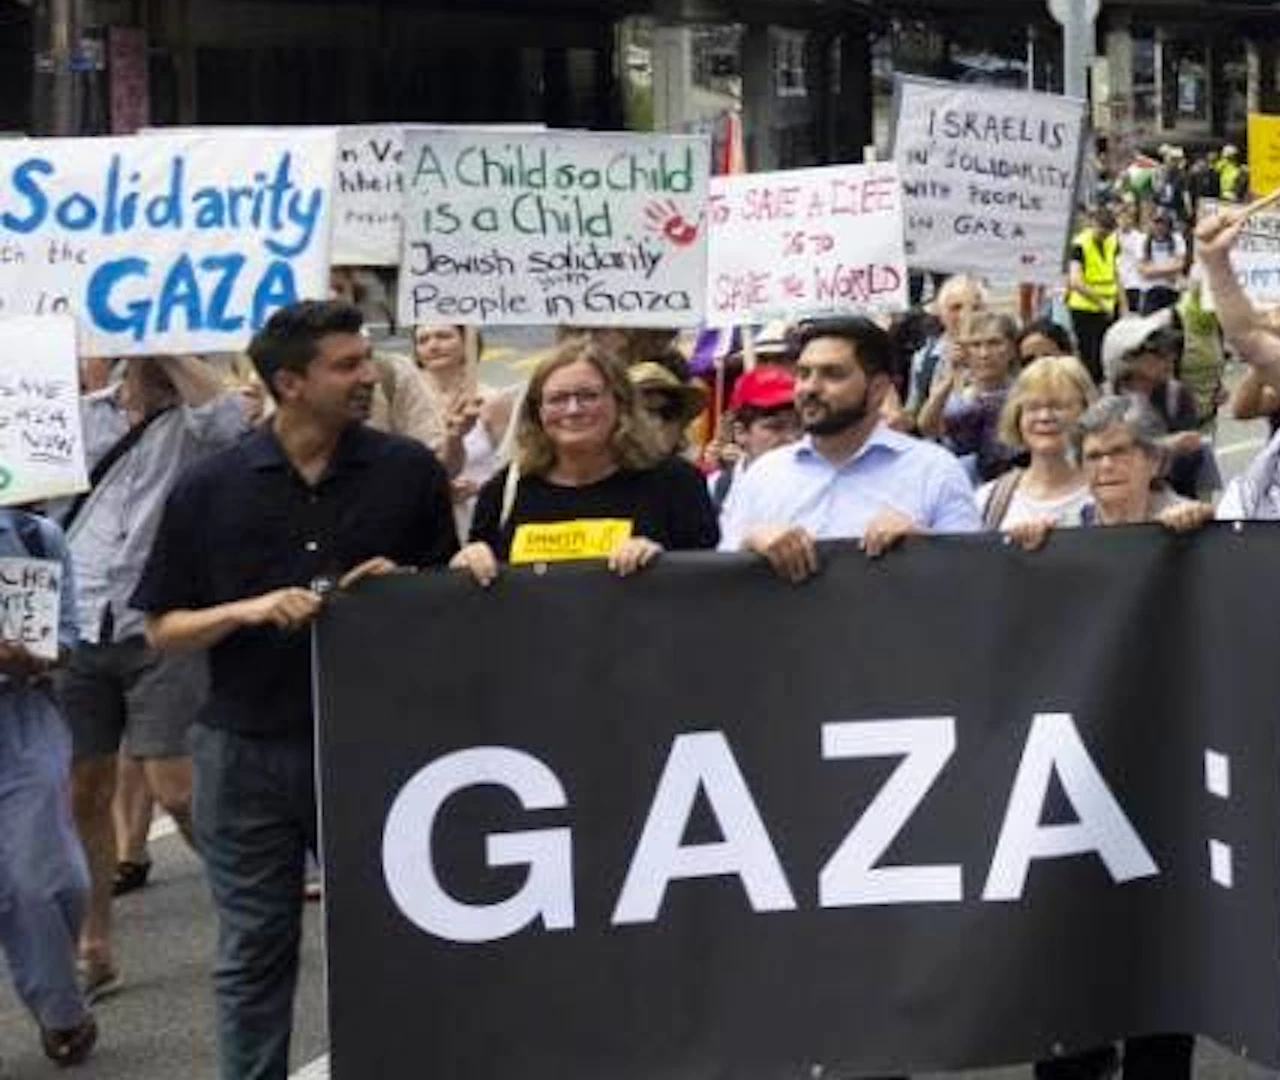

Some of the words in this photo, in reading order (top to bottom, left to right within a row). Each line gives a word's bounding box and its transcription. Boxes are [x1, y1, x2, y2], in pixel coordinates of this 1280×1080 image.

[928, 108, 1067, 151] ISRAELIS
[410, 143, 449, 189] A
[455, 143, 547, 188] Child
[606, 145, 692, 193] Child
[944, 146, 1073, 190] SOLIDARITY
[1, 151, 323, 258] Solidarity
[423, 202, 462, 235] is
[471, 206, 499, 232] a
[511, 191, 613, 238] Child
[968, 185, 1043, 211] PEOPLE
[953, 215, 1026, 240] GAZA
[48, 240, 88, 265] the
[410, 242, 515, 276] Jewish
[86, 251, 299, 341] GAZA
[412, 283, 531, 320] People
[544, 286, 575, 317] in
[583, 280, 691, 313] Gaza
[814, 263, 901, 303] WORLD
